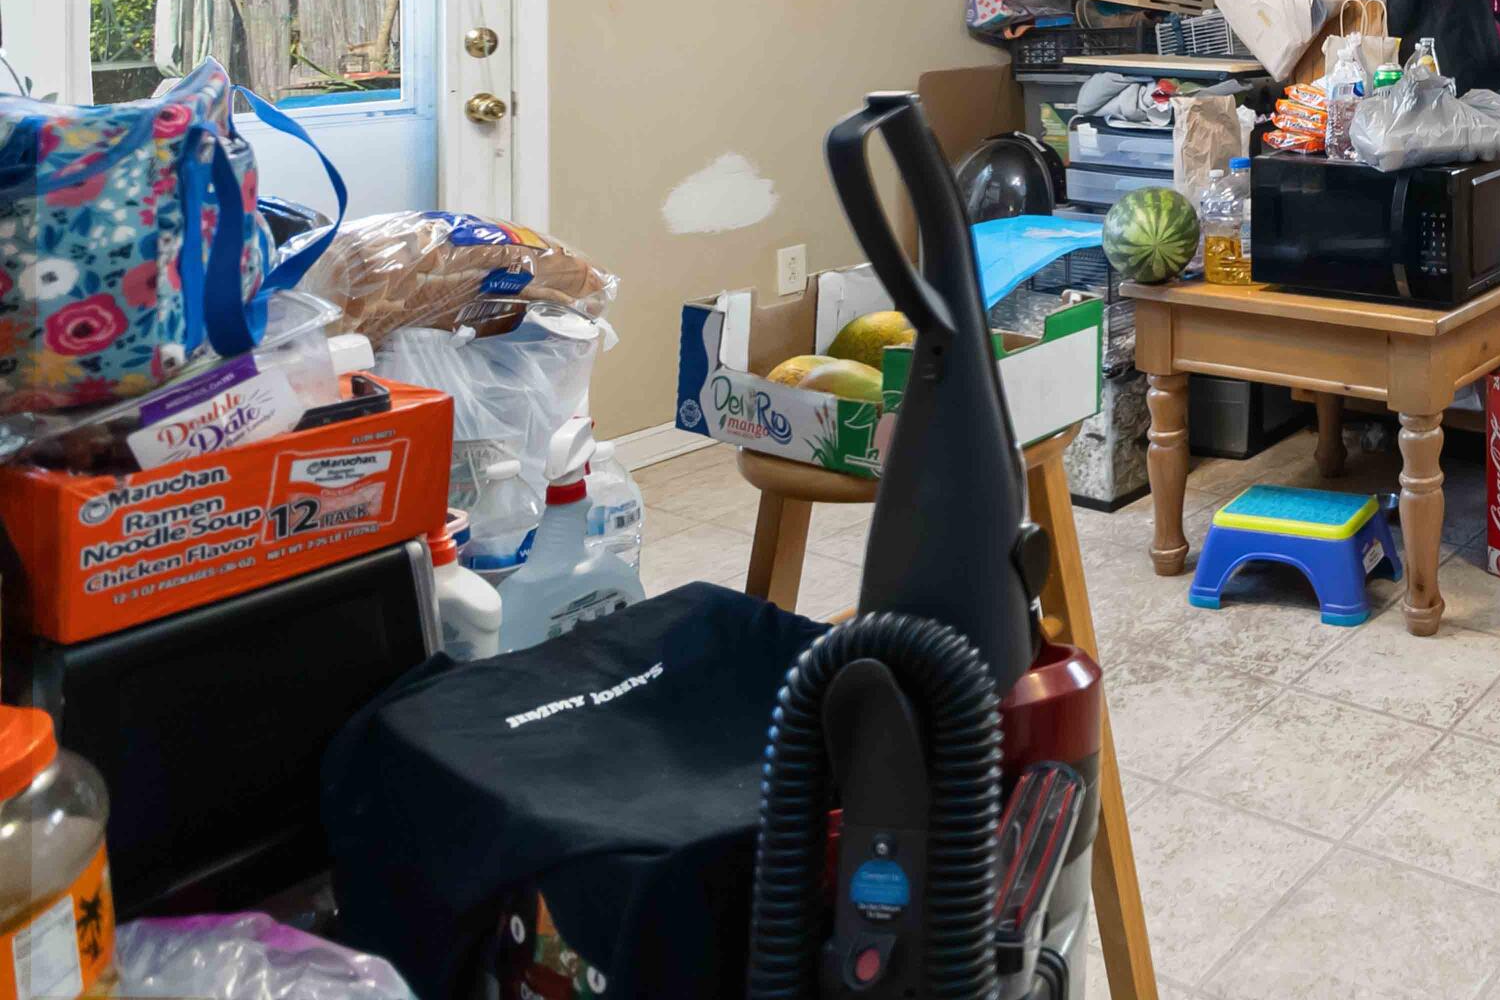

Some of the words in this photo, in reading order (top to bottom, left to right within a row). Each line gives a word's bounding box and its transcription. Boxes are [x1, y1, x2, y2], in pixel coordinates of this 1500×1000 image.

[710, 375, 744, 416] Del
[157, 392, 243, 447] Double
[188, 406, 259, 452] Date
[728, 416, 770, 439] mango
[320, 455, 376, 468] Maruchan
[107, 466, 230, 507] Maruchan
[123, 496, 225, 535] Ramen
[267, 497, 321, 540] 12
[322, 505, 369, 528] PACK
[81, 526, 187, 570] Noodle
[191, 506, 262, 537] Soup
[84, 555, 182, 593] Chicken
[186, 534, 258, 563] Flavor
[505, 695, 585, 728] JIMMY
[589, 661, 664, 705] JOHN'S
